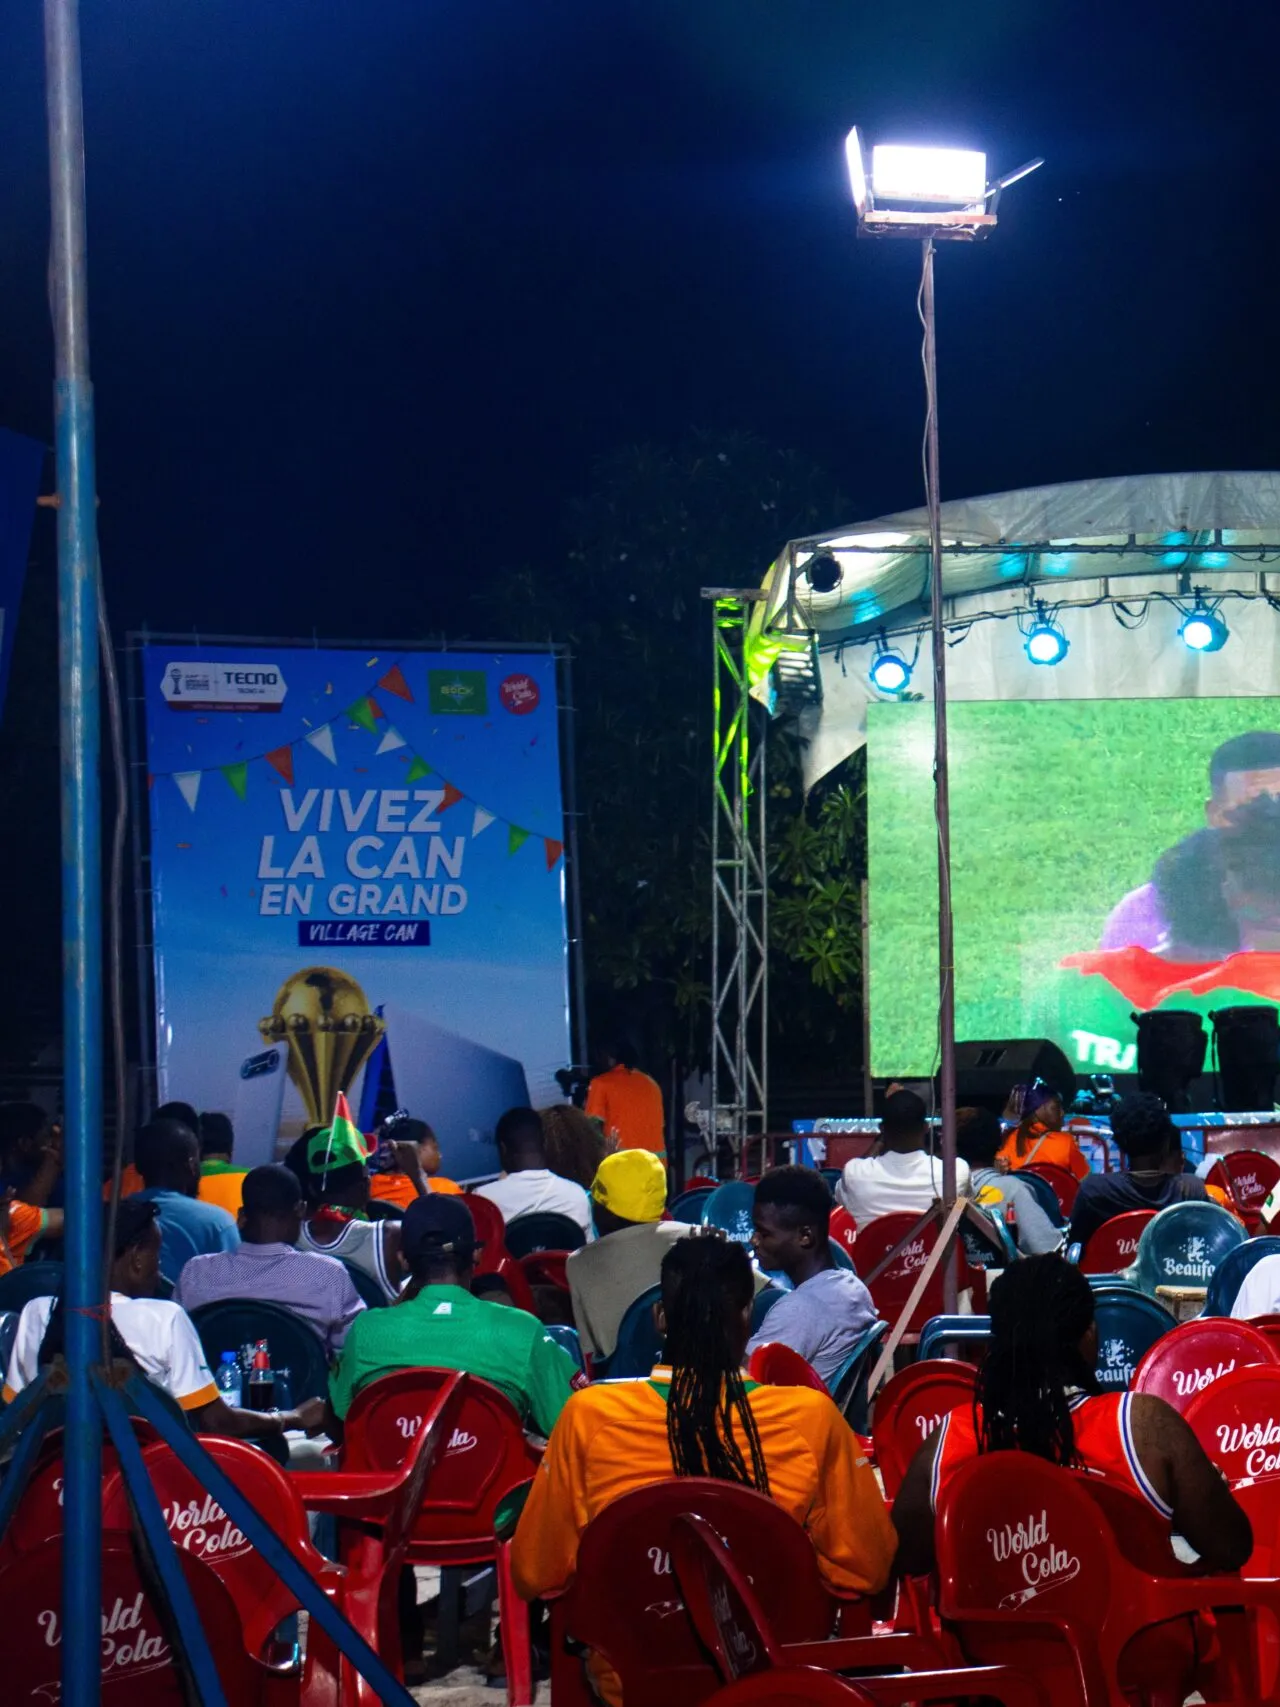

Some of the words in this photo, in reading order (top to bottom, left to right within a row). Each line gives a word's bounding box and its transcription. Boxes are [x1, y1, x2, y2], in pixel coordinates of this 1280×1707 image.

[223, 671, 278, 685] TECNO
[279, 788, 446, 833] VIVEZ
[256, 835, 326, 880] LA
[345, 836, 466, 880] CAN
[258, 883, 314, 916] EN
[327, 884, 469, 917] GRAND
[308, 922, 380, 942] VILLAGE
[384, 923, 419, 942] CAN
[986, 1509, 1049, 1562] World
[1021, 1543, 1081, 1586] Cola
